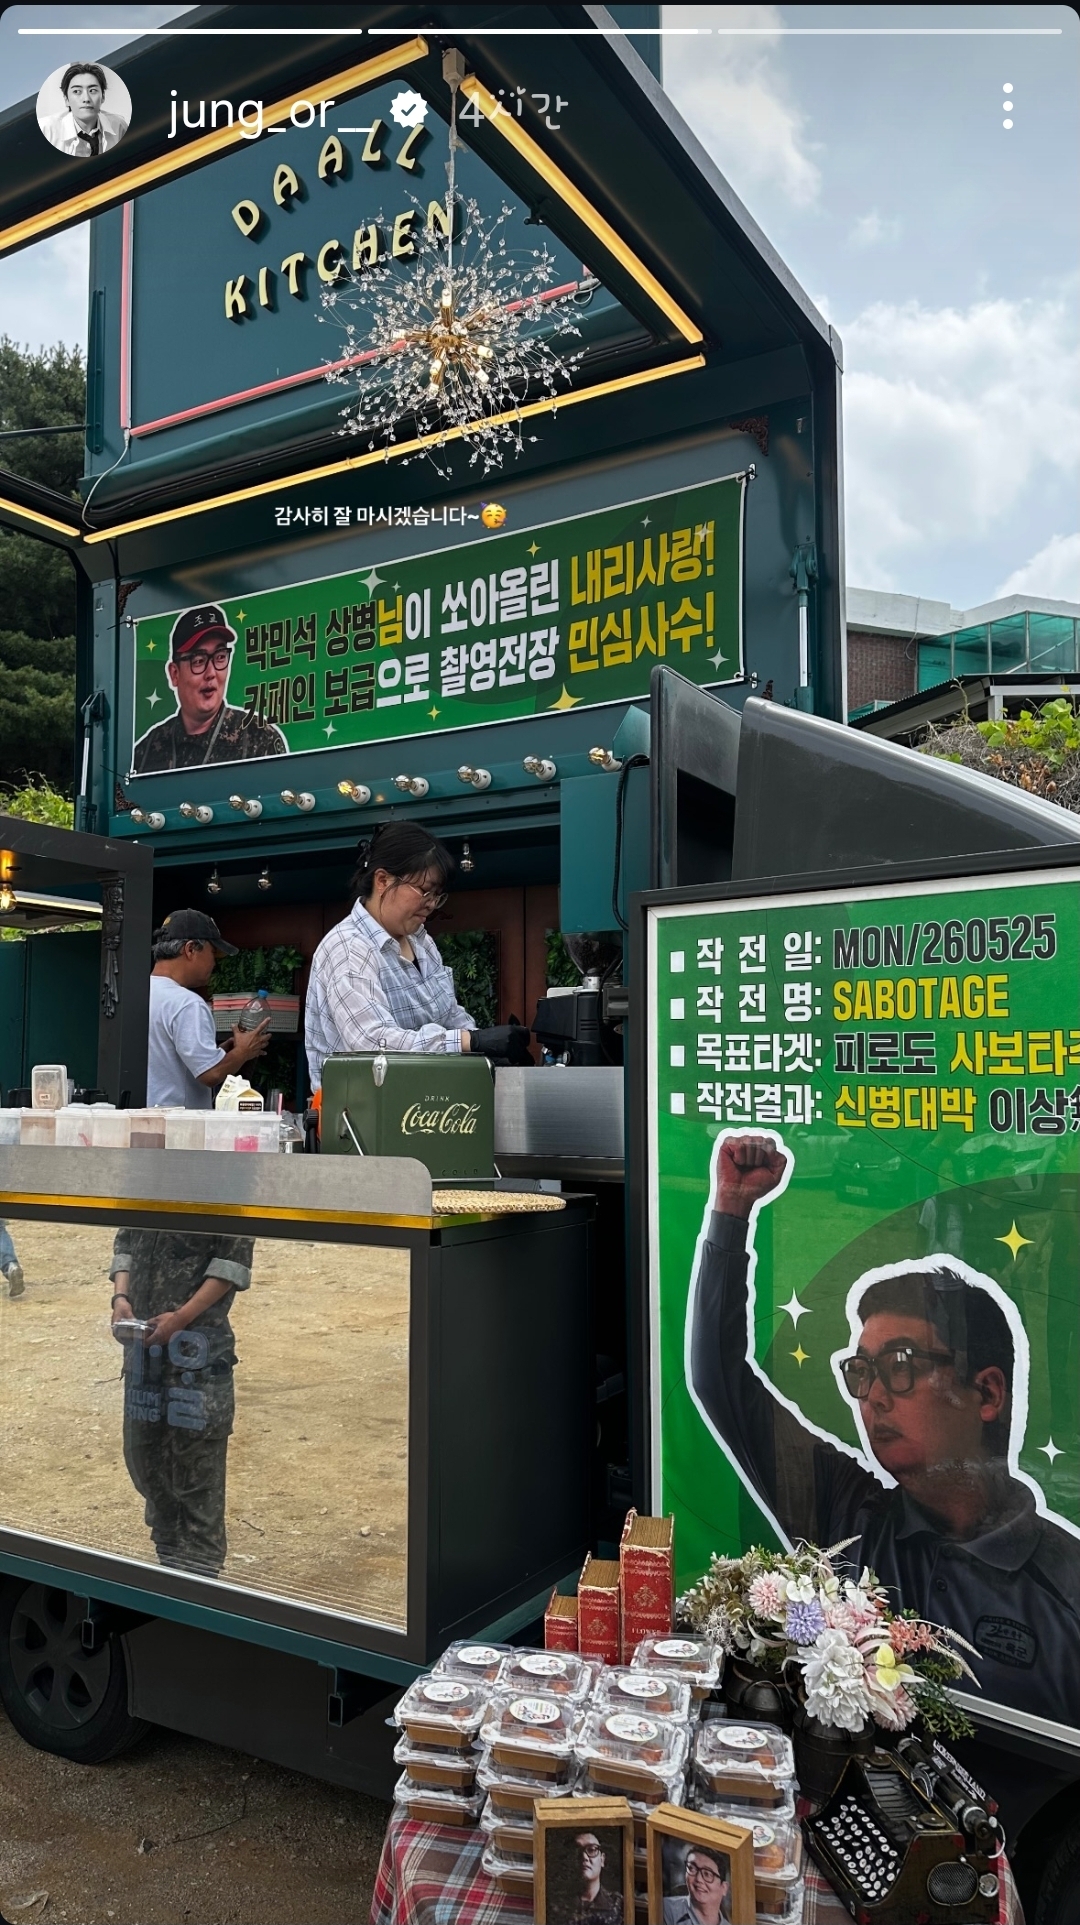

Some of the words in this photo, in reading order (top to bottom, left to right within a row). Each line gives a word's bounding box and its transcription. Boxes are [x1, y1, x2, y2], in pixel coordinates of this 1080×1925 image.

[231, 119, 424, 237] DAALL
[225, 200, 452, 319] KITCHEN
[245, 613, 317, 671] 박민석
[326, 589, 431, 658] 상병님이
[440, 559, 560, 633] 쏘아올린
[570, 520, 715, 606] 내리사랑!
[242, 673, 316, 729] 카페인
[324, 652, 430, 717] 보급으로
[440, 626, 560, 698] 촬영전장
[568, 591, 715, 674] 민심사수!
[832, 913, 1057, 969] MON/260525
[832, 974, 1010, 1021] SABOTAGE
[697, 1033, 822, 1073] 목표타겟:
[834, 1031, 937, 1075] 피로도
[697, 1082, 822, 1125] 작전결과:
[834, 1085, 976, 1132] 신병대박
